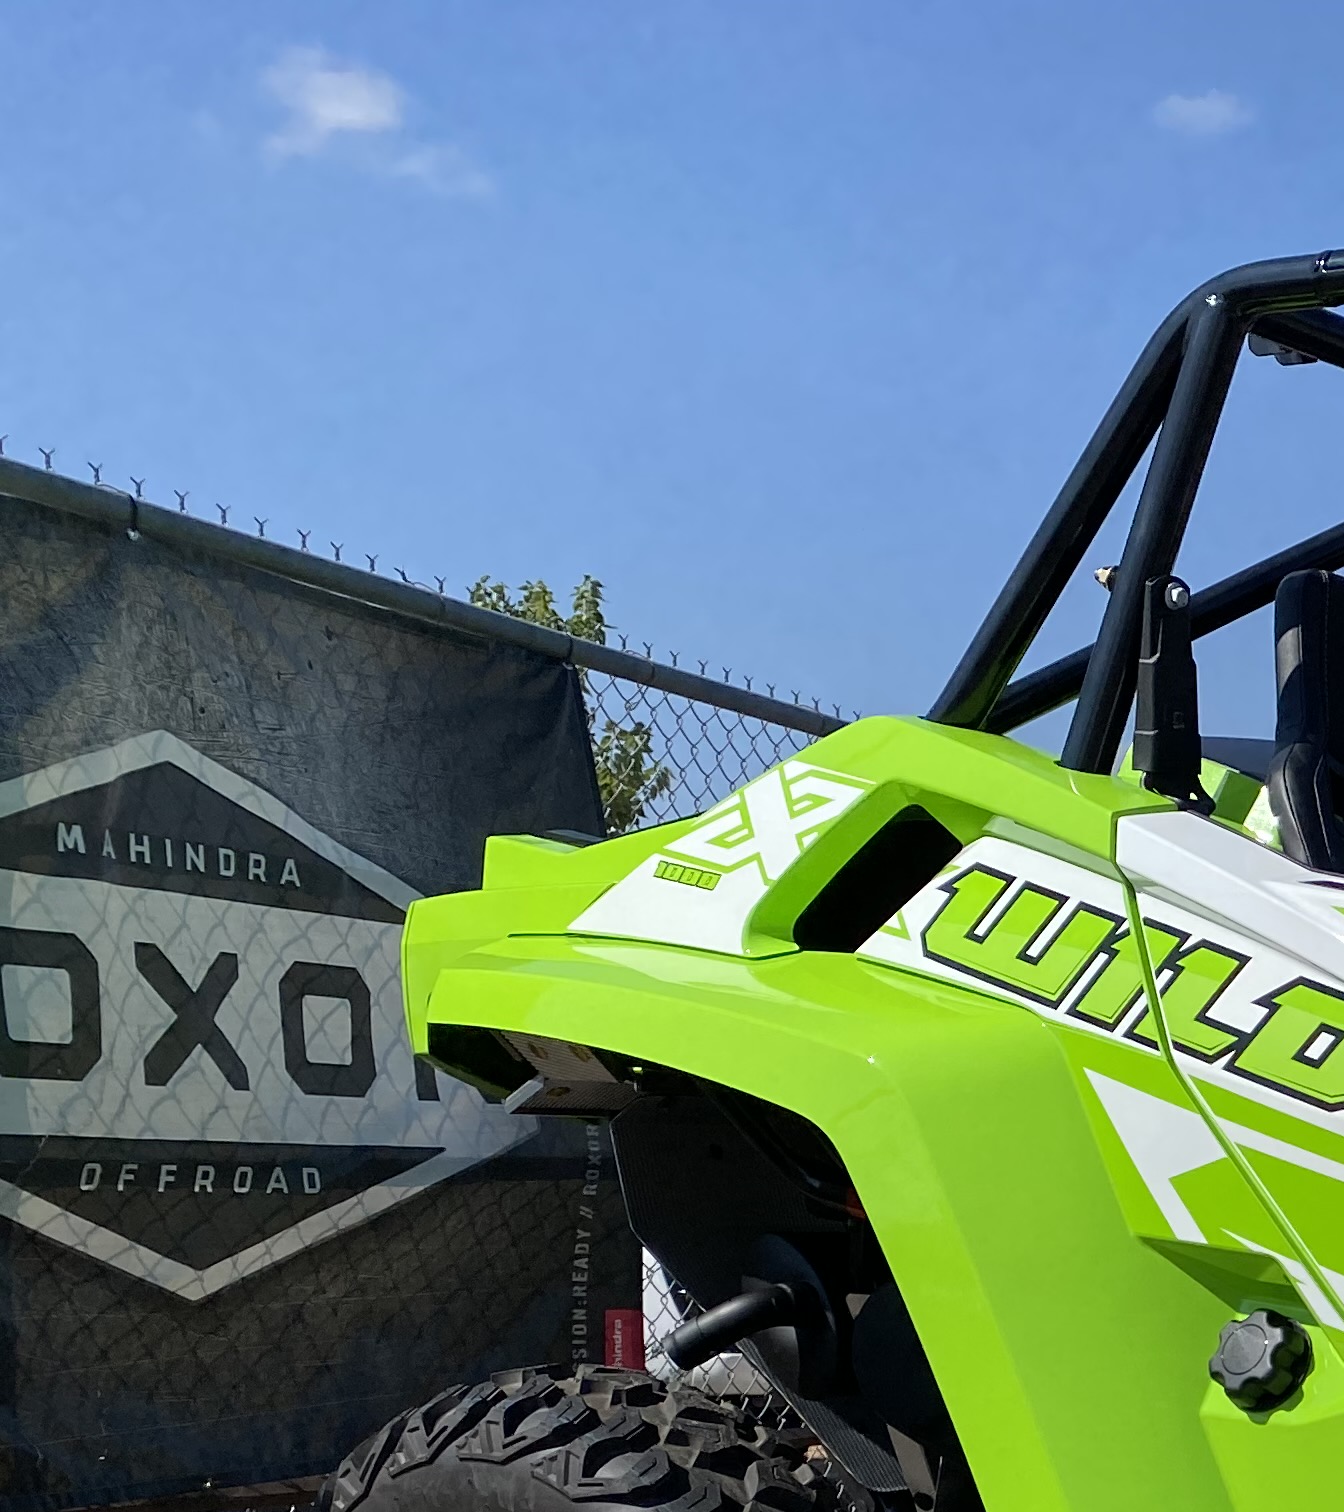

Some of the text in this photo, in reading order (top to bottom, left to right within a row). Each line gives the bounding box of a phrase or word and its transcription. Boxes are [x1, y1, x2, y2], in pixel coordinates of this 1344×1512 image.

[56, 821, 301, 888] MAHINDRA
[653, 860, 722, 891] 1000
[0, 926, 502, 1104] OXO
[79, 1163, 321, 1194] OFFROAD
[582, 1123, 600, 1196] ROXOR
